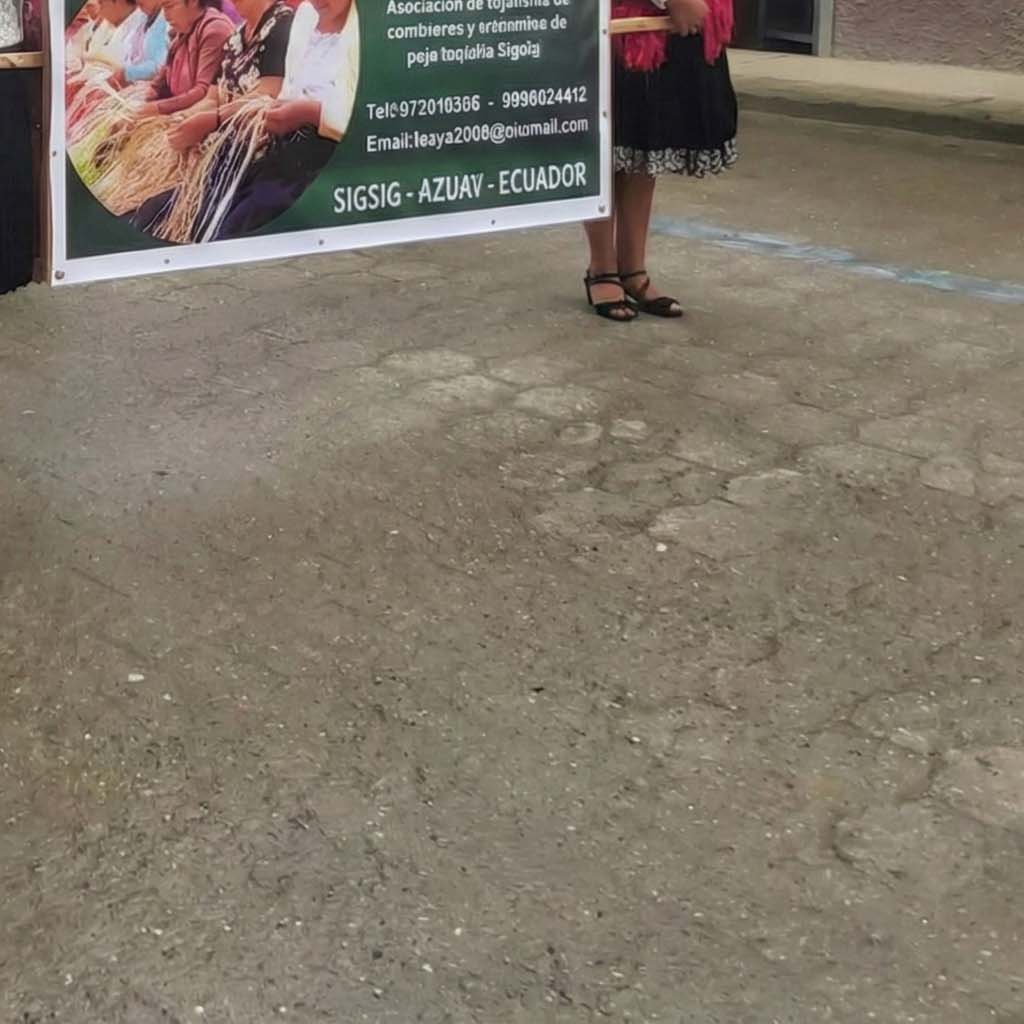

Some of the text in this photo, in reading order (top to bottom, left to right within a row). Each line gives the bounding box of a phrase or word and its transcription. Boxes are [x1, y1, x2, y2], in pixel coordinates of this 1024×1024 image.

[466, 23, 476, 39] y
[550, 14, 568, 30] de
[333, 182, 402, 214] SIGSIG
[498, 162, 588, 195] ECUADOR
